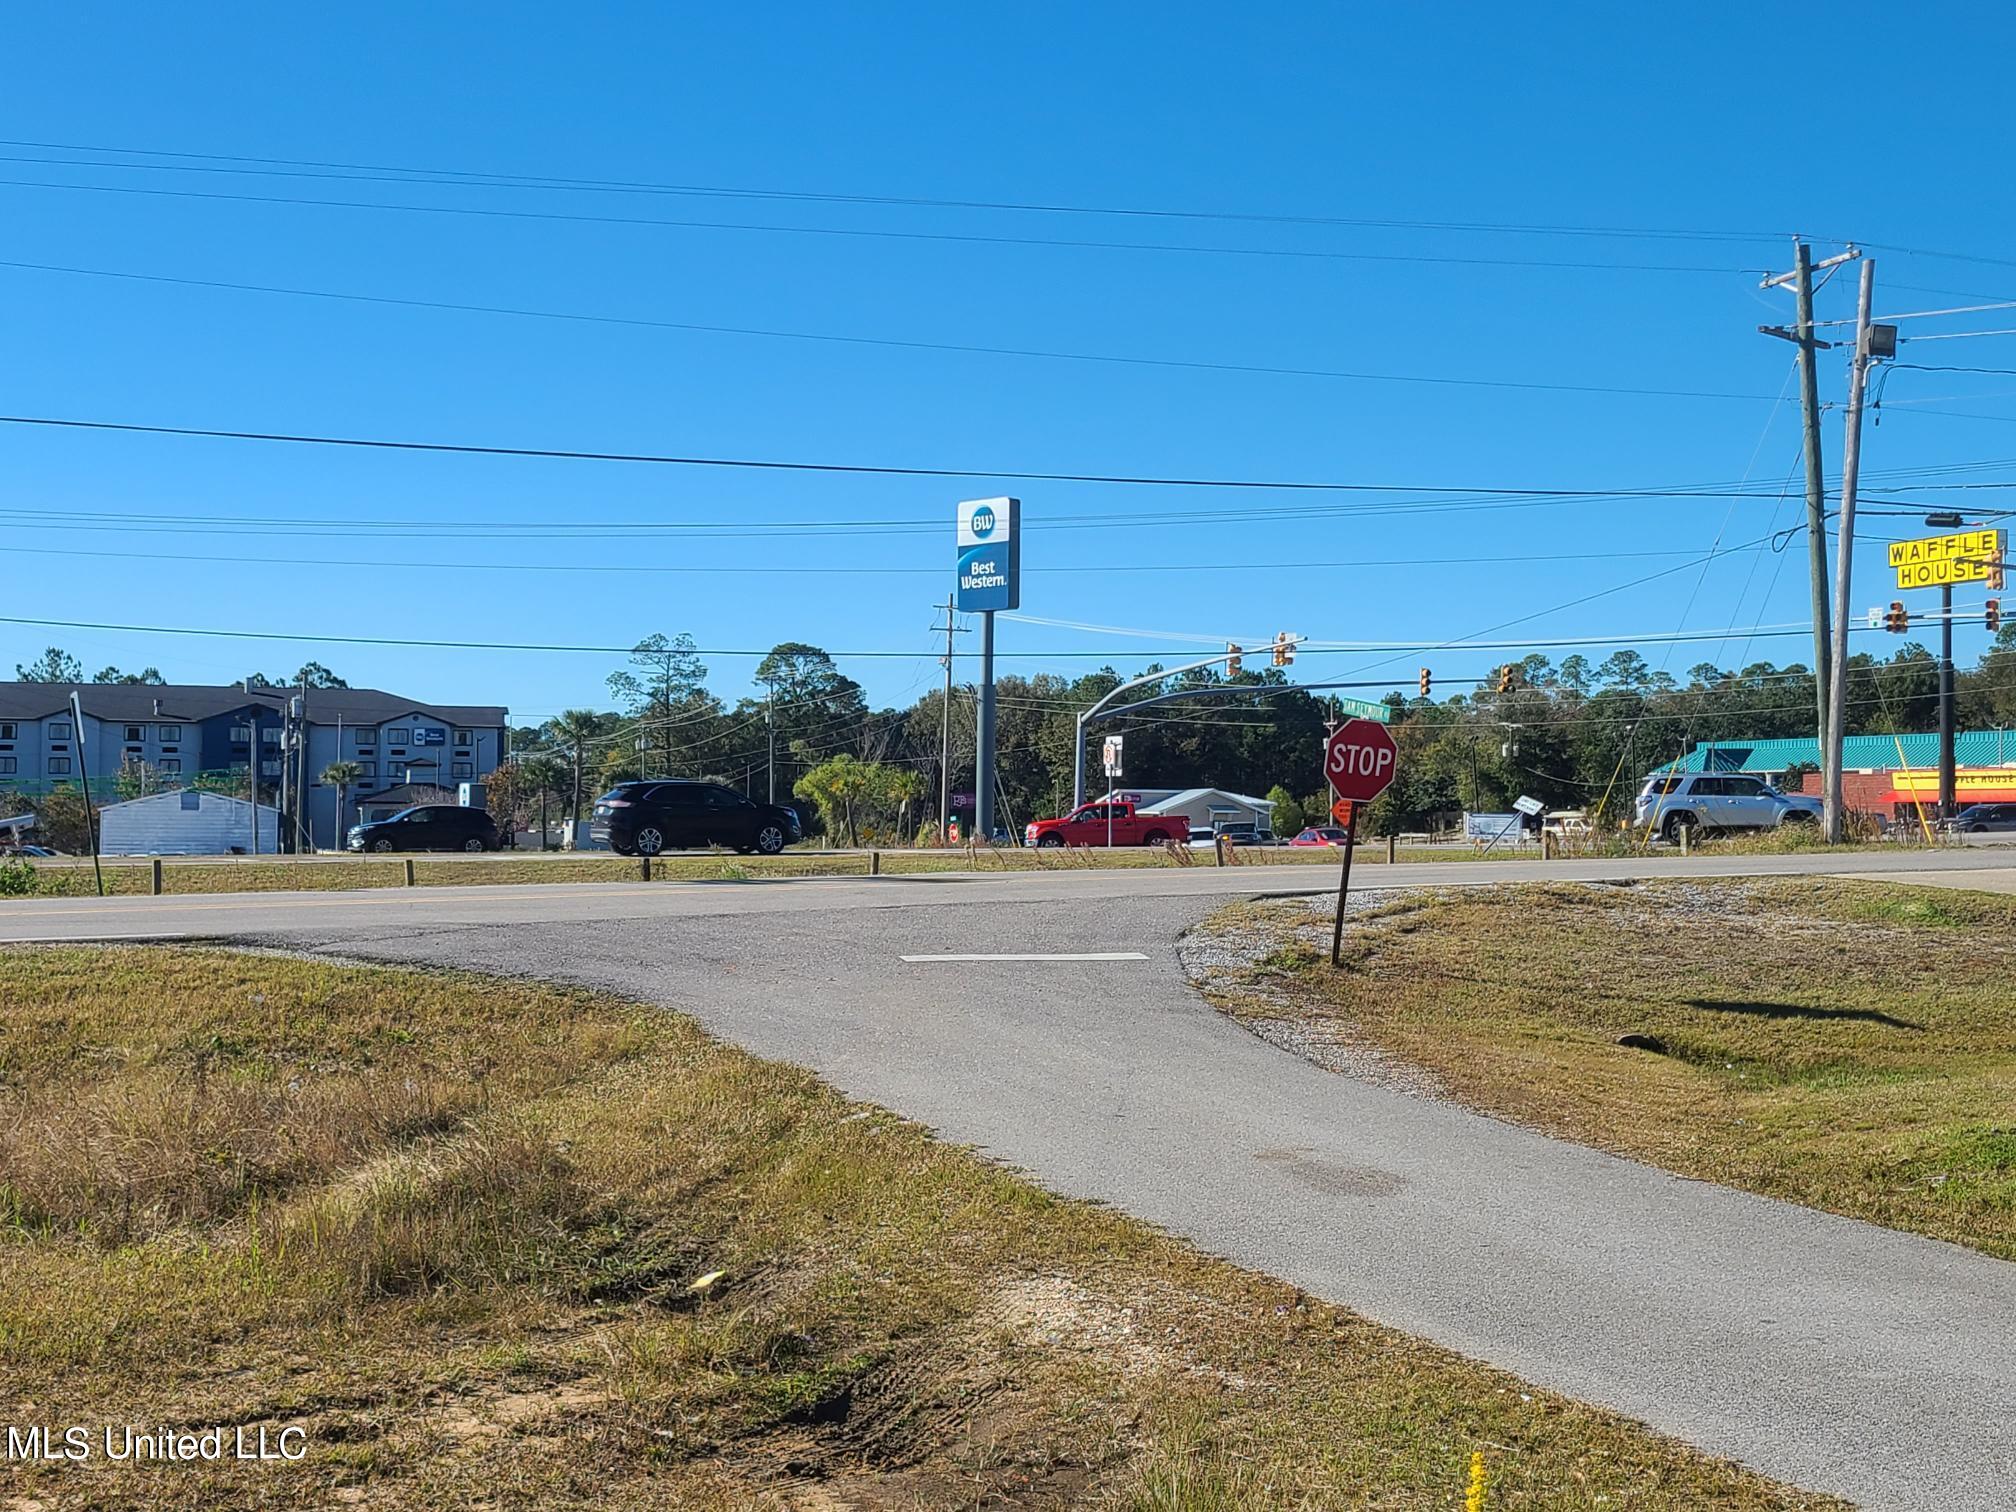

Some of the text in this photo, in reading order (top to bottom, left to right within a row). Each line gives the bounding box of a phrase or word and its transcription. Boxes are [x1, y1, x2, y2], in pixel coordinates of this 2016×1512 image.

[973, 514, 993, 531] BW
[1891, 533, 1993, 563] WAFFLE
[971, 561, 995, 576] Best
[1901, 558, 1984, 585] HOUSE
[1330, 743, 1392, 777] STOP
